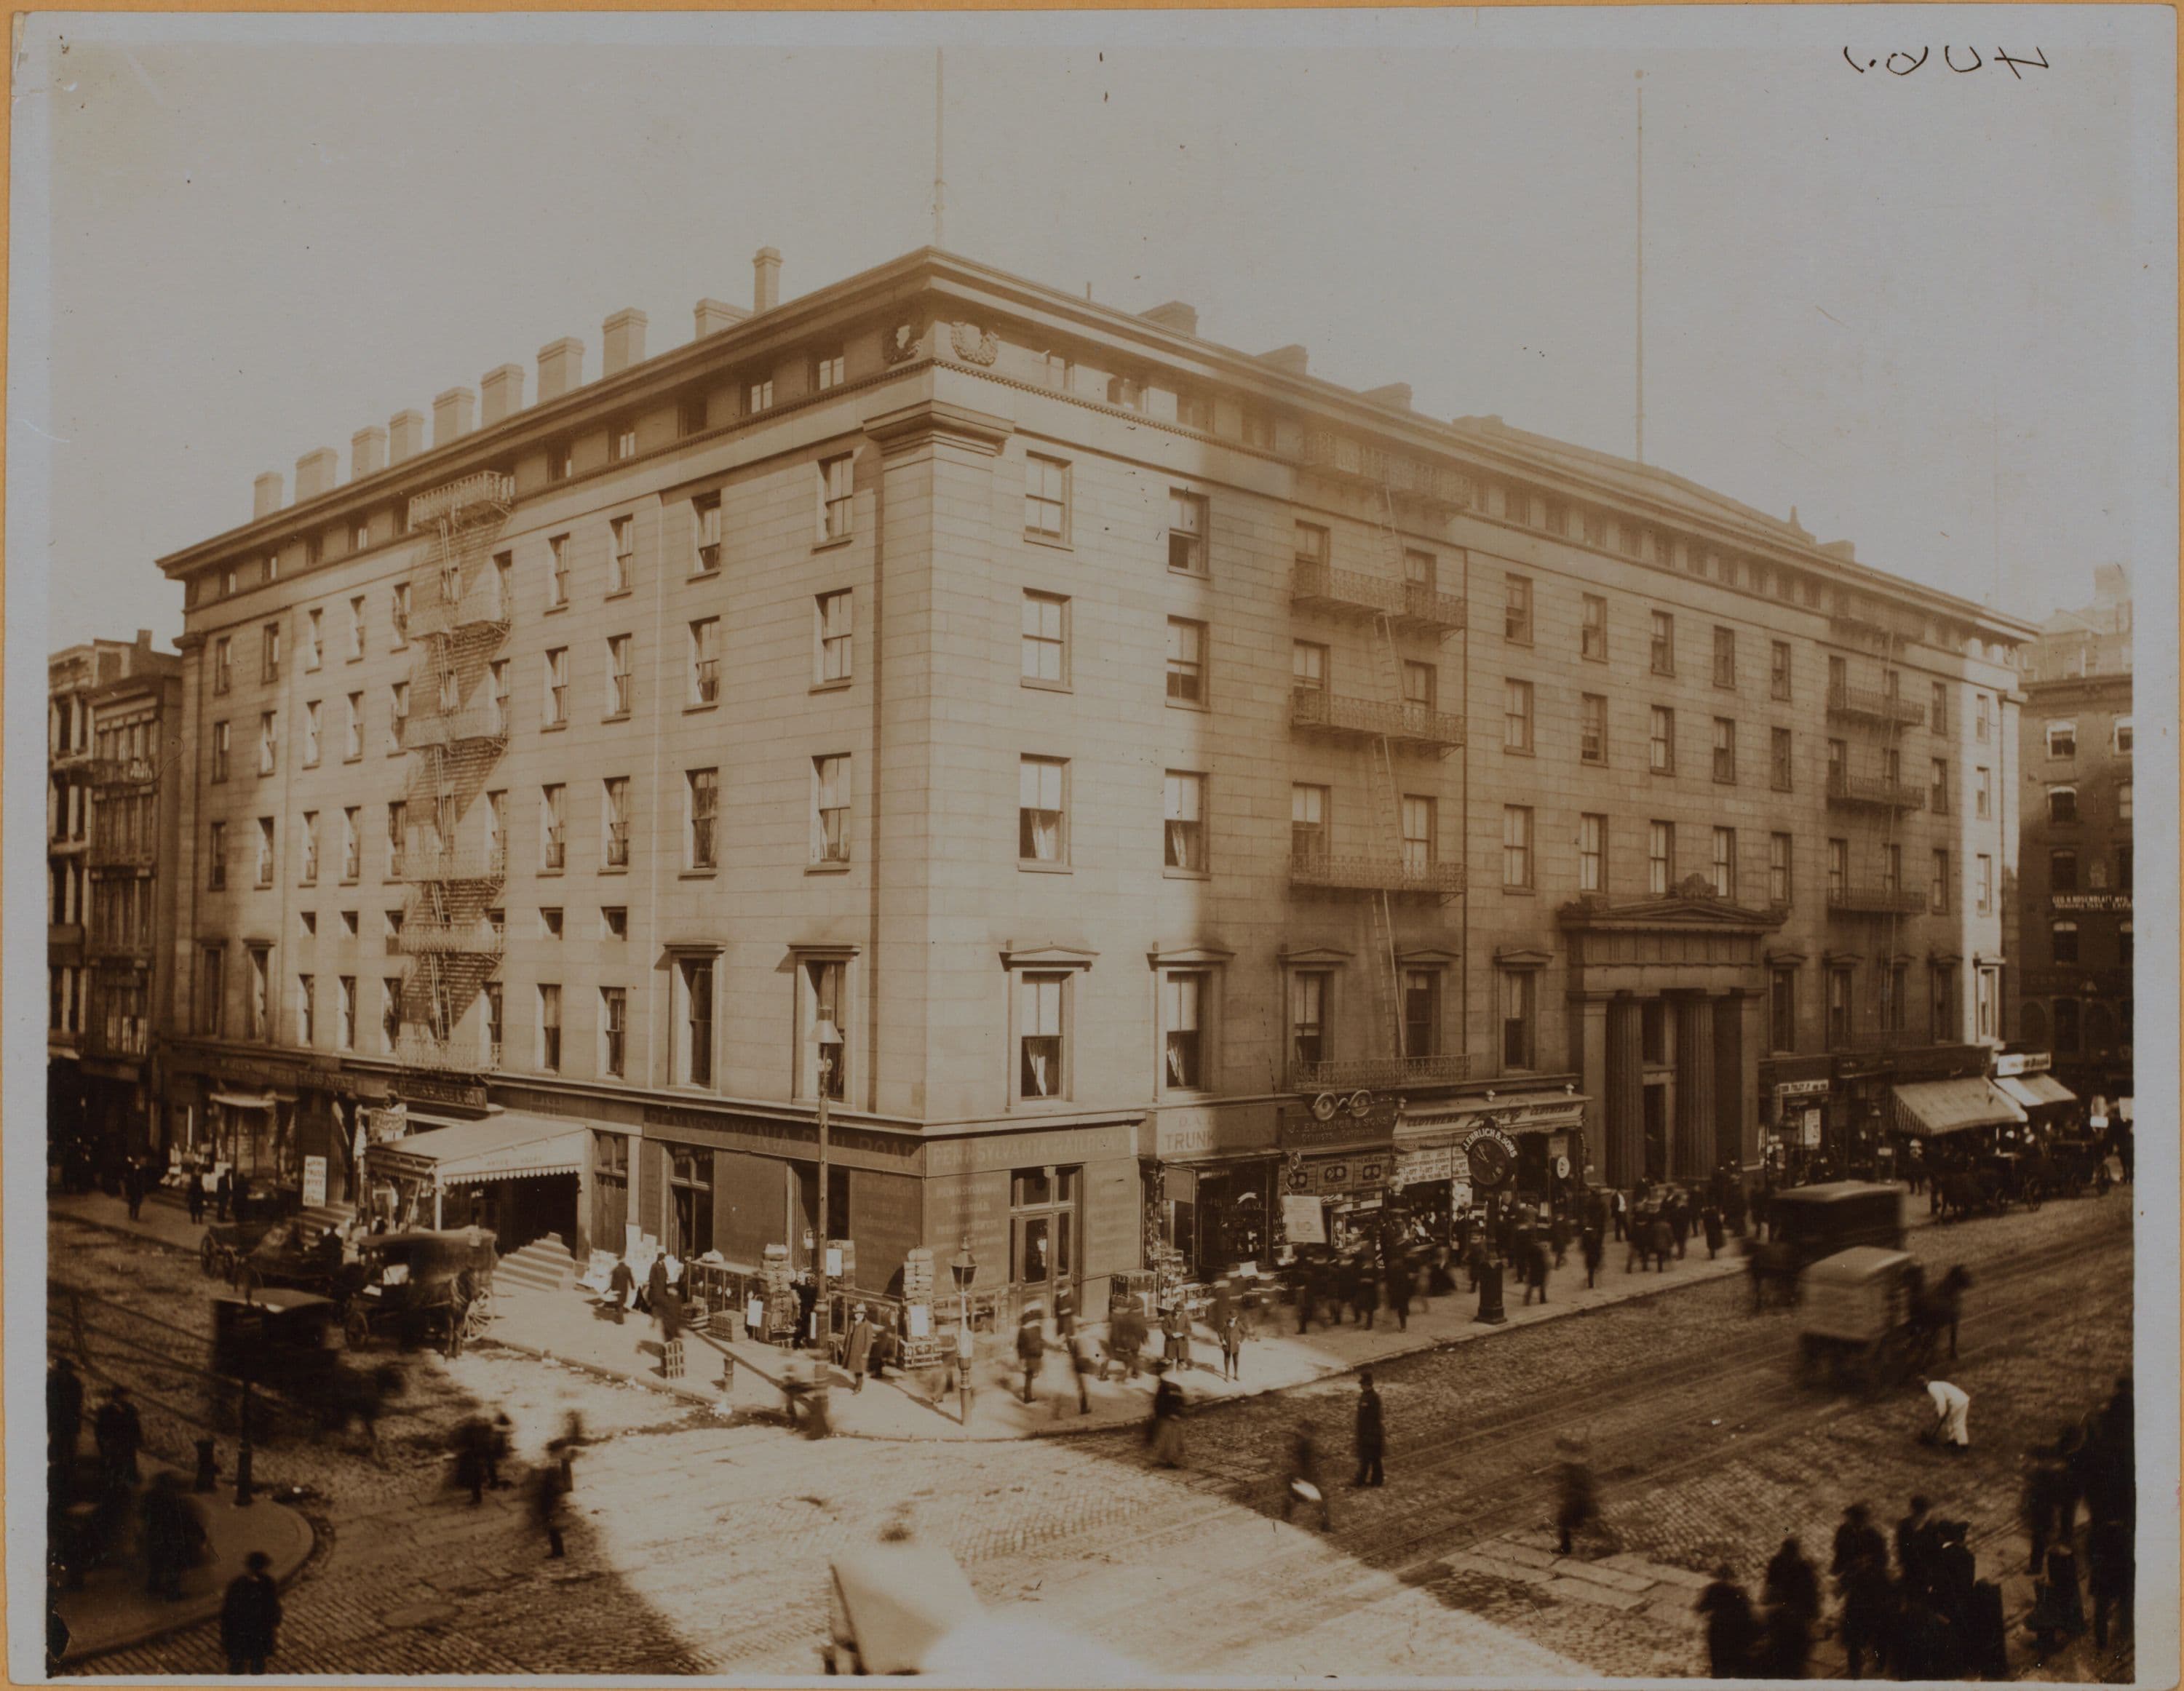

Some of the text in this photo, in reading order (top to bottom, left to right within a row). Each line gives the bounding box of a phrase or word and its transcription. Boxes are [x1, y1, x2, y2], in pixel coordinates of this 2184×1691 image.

[1303, 1118, 1351, 1133] EHRLICH
[1363, 1116, 1389, 1128] SONS
[933, 1139, 1049, 1168] PENNSYLVANIA
[1466, 1128, 1496, 1143] EHRLICH
[1495, 1131, 1501, 1141] &
[1501, 1137, 1518, 1158] SONS
